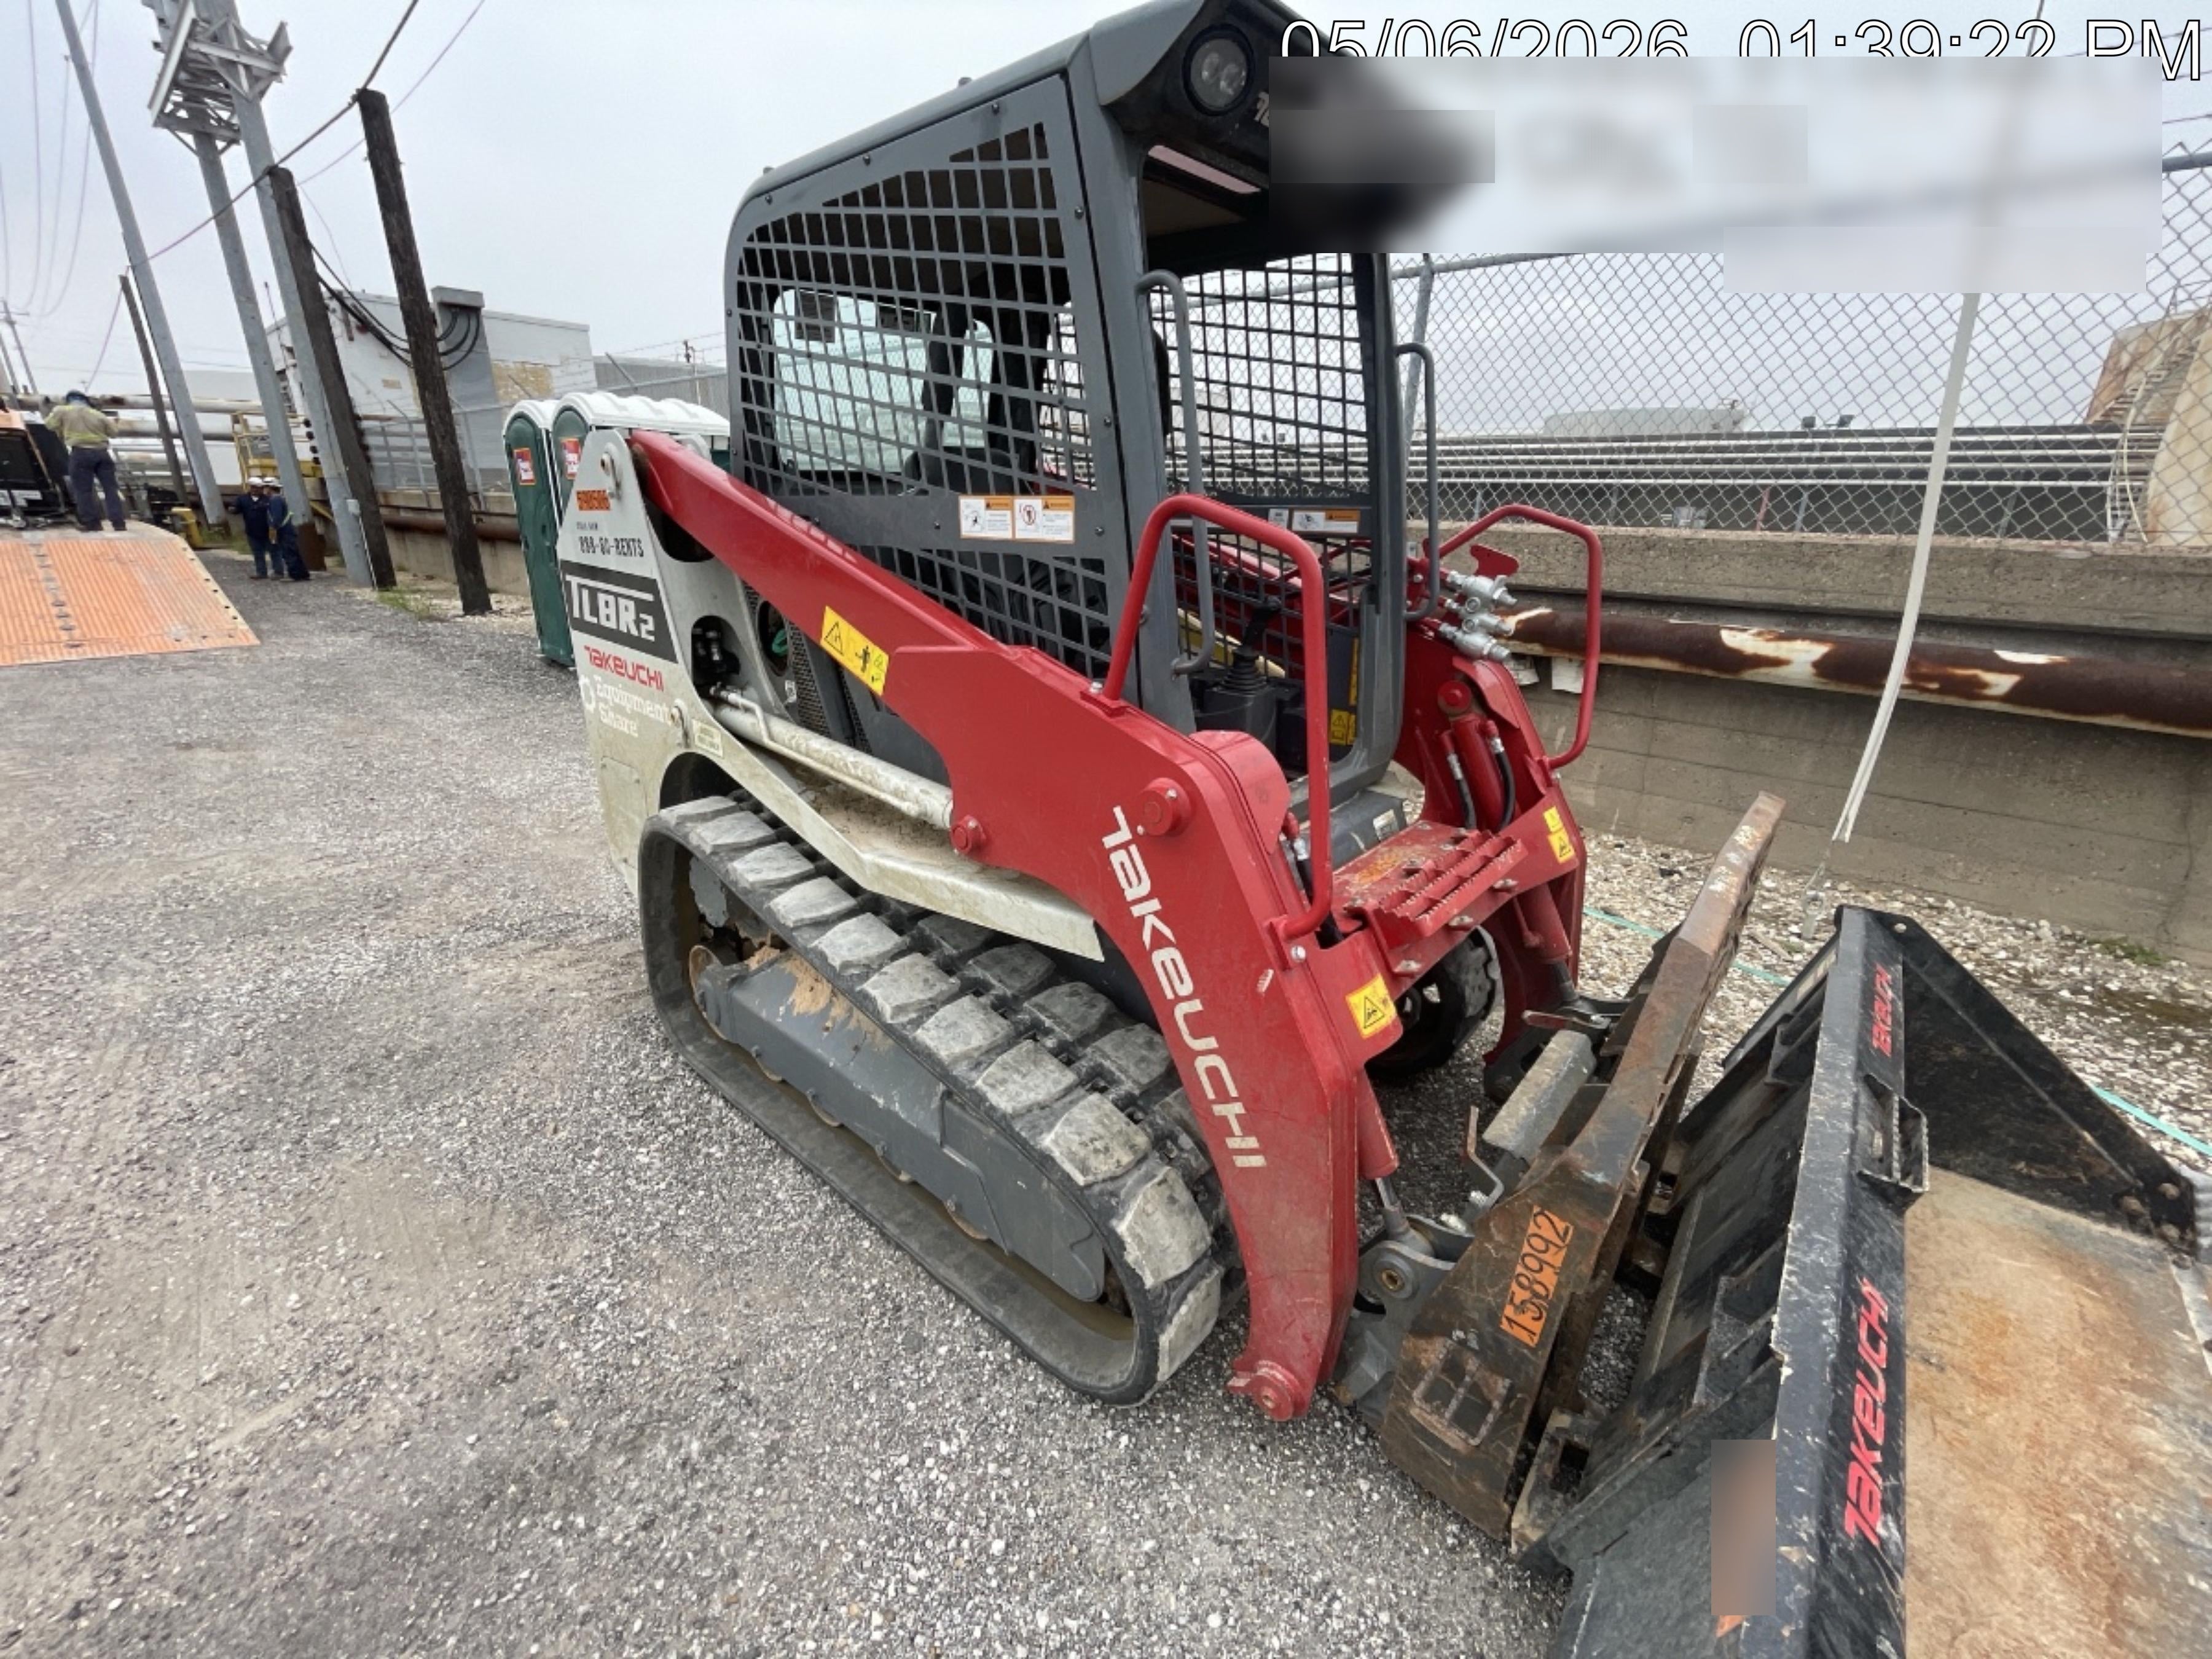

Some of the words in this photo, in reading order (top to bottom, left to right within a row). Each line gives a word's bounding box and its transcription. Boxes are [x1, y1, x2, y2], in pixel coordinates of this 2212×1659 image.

[584, 645, 664, 691] TAKEUCHI
[598, 702, 638, 737] Share
[1102, 805, 1267, 1168] TAKEUCHI
[1503, 1208, 1571, 1342] 158992
[1844, 1276, 1888, 1547] TAKEUCHI
